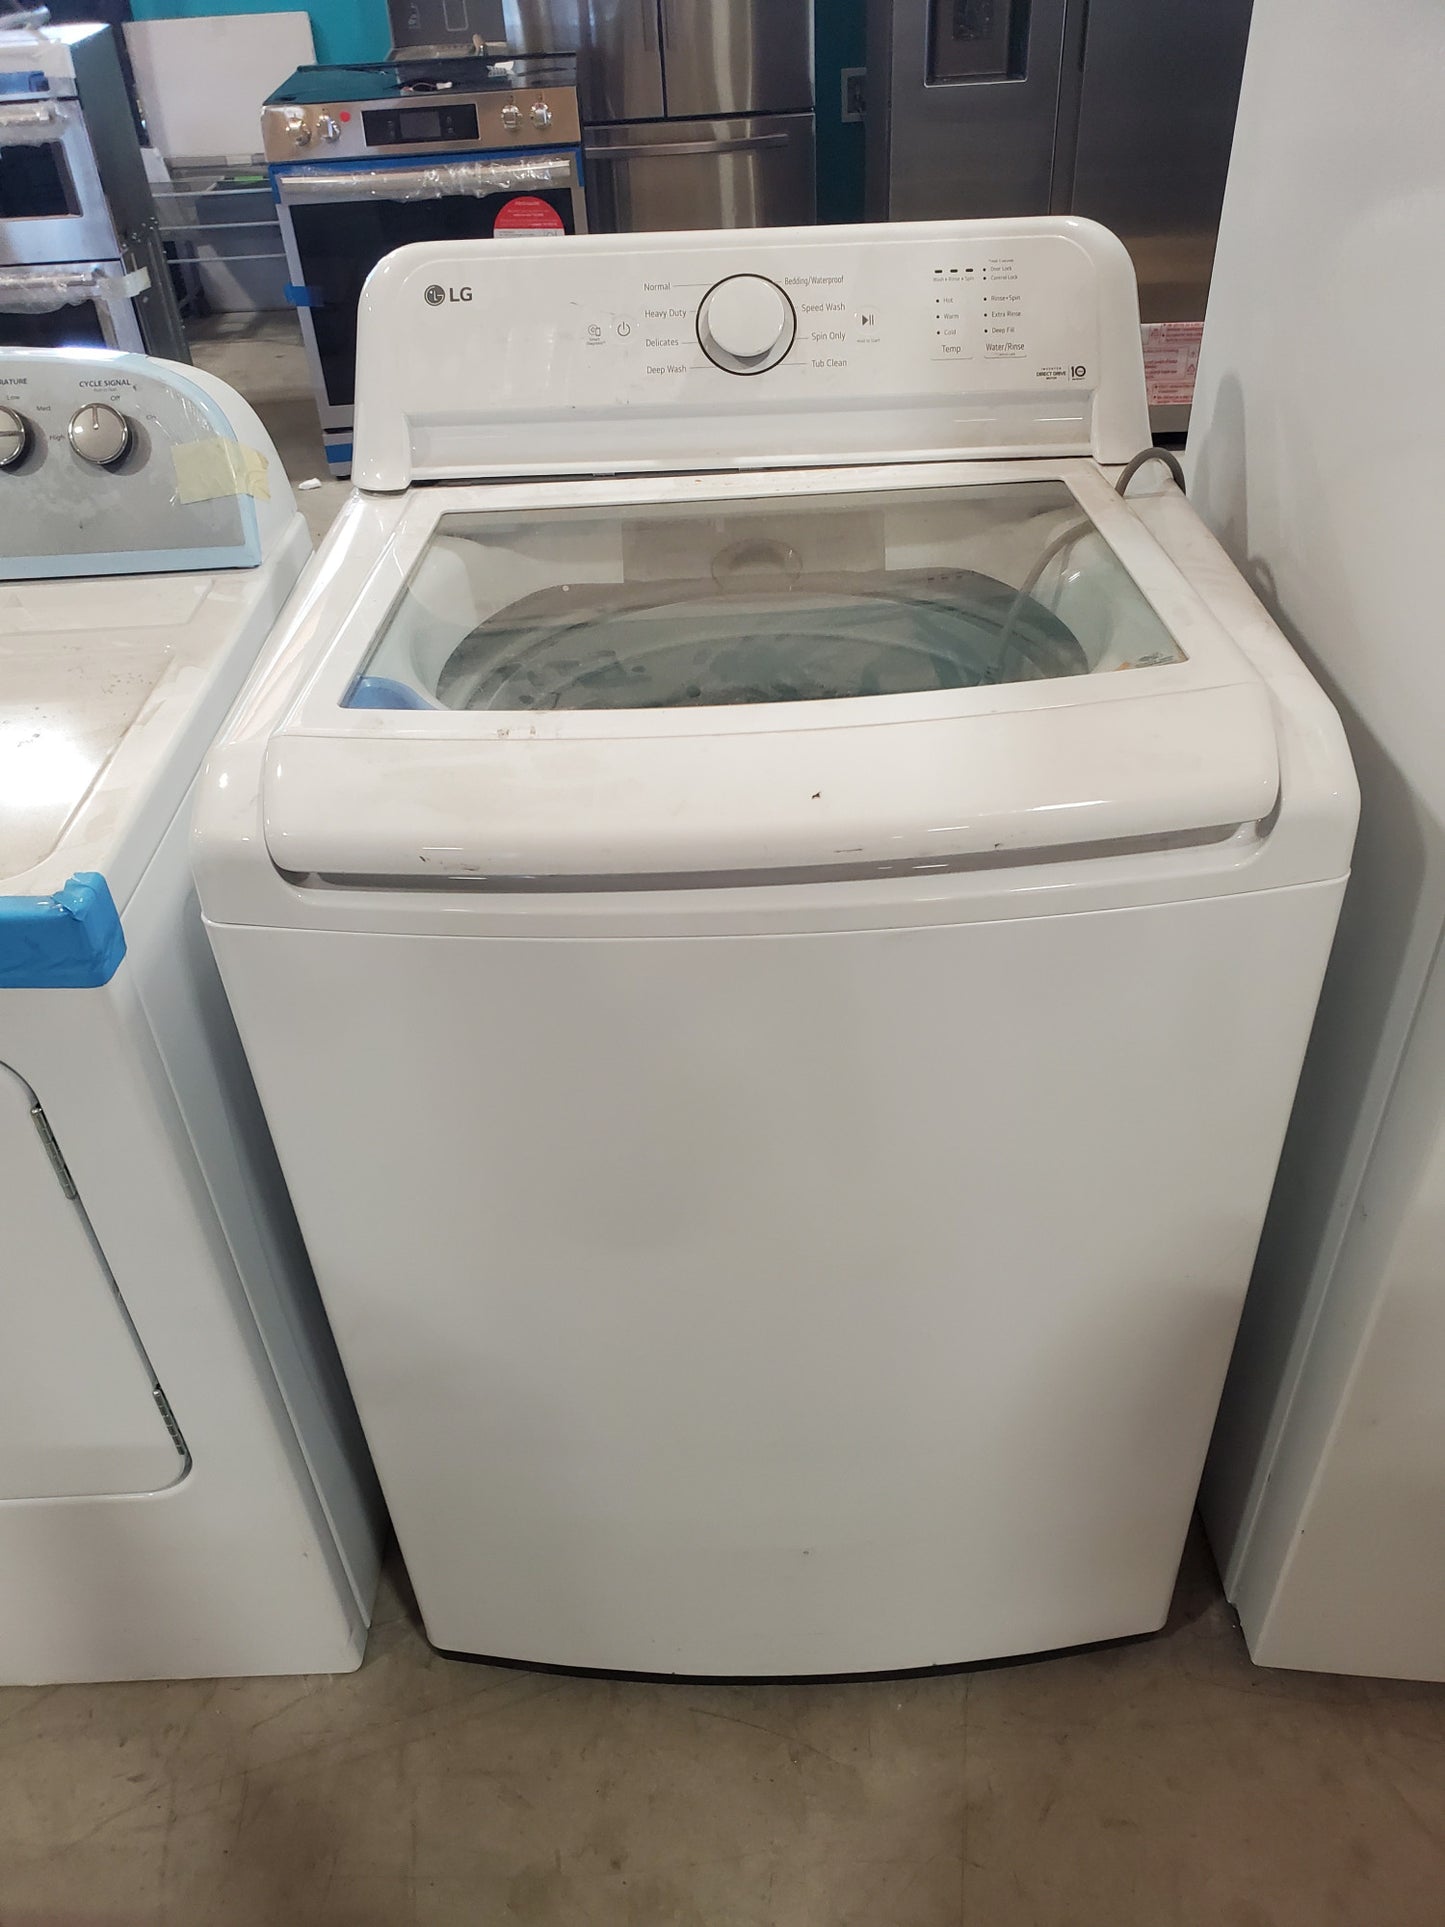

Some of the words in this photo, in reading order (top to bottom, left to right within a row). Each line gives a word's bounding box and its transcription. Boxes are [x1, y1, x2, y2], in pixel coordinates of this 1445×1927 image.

[784, 274, 844, 287] Bedding/Waterproof
[643, 282, 671, 291] Normal
[449, 286, 473, 302] LG
[801, 303, 824, 313] Speed
[825, 302, 846, 311] Wash
[644, 310, 667, 319] Heavy
[668, 308, 687, 319] Duty
[811, 331, 828, 342] Spin
[828, 330, 846, 342] Only
[645, 338, 679, 347] Delicates
[985, 342, 1025, 352] Water/Rinse
[941, 344, 962, 354] Temp
[811, 359, 825, 368] Tub
[826, 358, 848, 368] Clean
[646, 365, 666, 375] Deep
[666, 364, 687, 373] Wash
